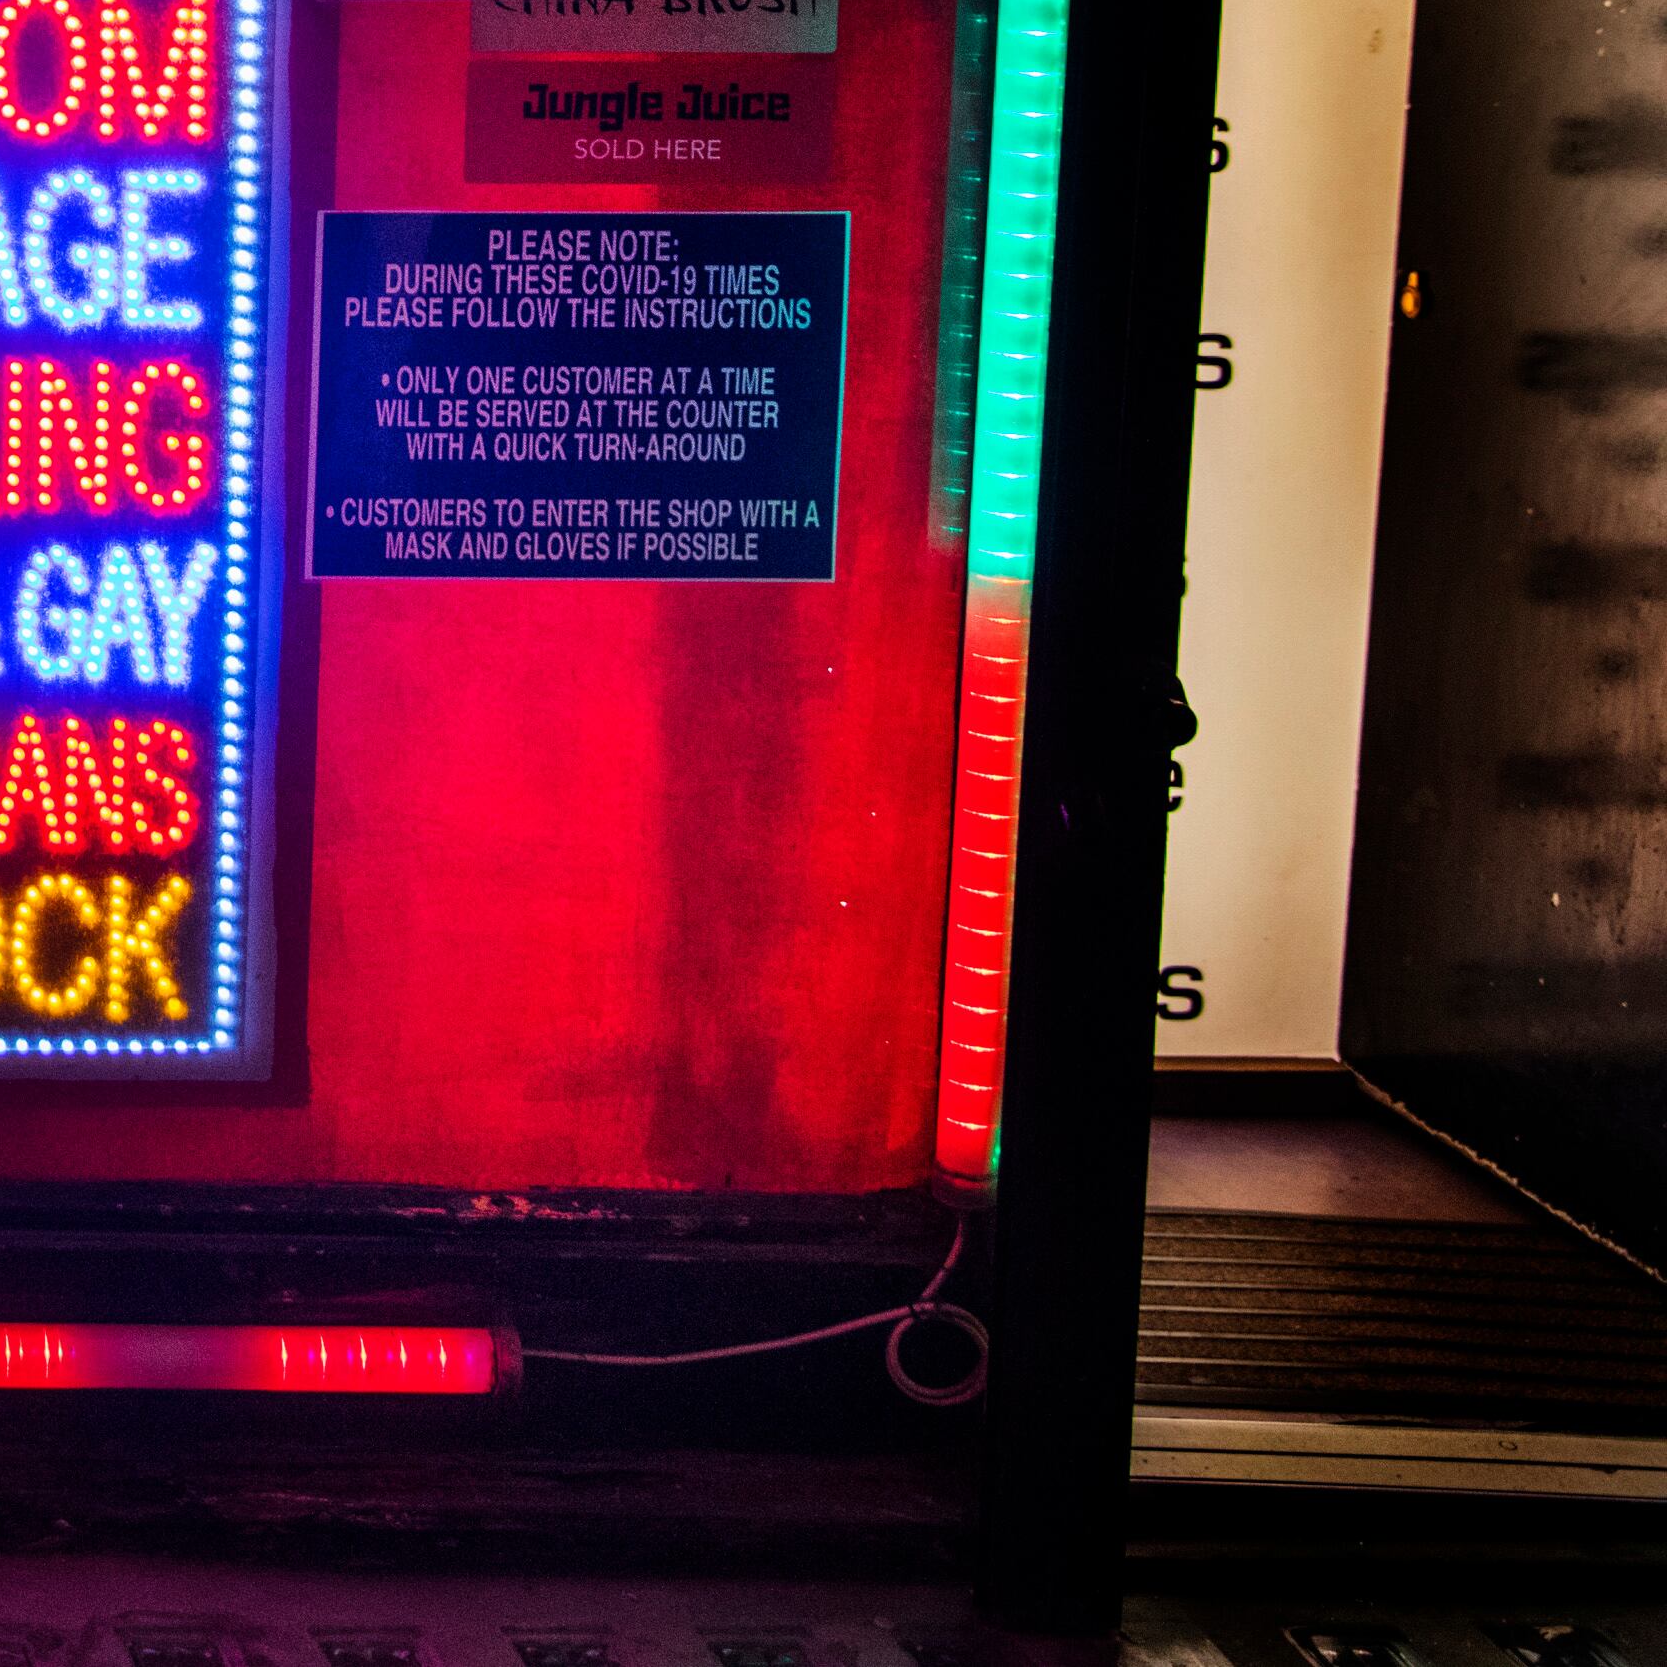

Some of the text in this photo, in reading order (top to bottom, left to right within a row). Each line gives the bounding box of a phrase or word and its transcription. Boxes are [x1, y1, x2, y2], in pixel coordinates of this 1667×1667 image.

[523, 82, 790, 131] Jungle Juice
[574, 138, 721, 160] SOLD HERE
[488, 230, 679, 261] PLEASE NOTE:
[385, 263, 780, 296] DURING THESE COVID-19 TIMES
[345, 297, 811, 329] PLEASE FOLLOW THE INSTRUCTIONS
[341, 498, 819, 528] CUSTOMERS TO ENTER THE SHOP WITH A
[385, 532, 758, 560] MASK AND GLOVES IF POSSIBLE
[17, 541, 219, 684] GAY
